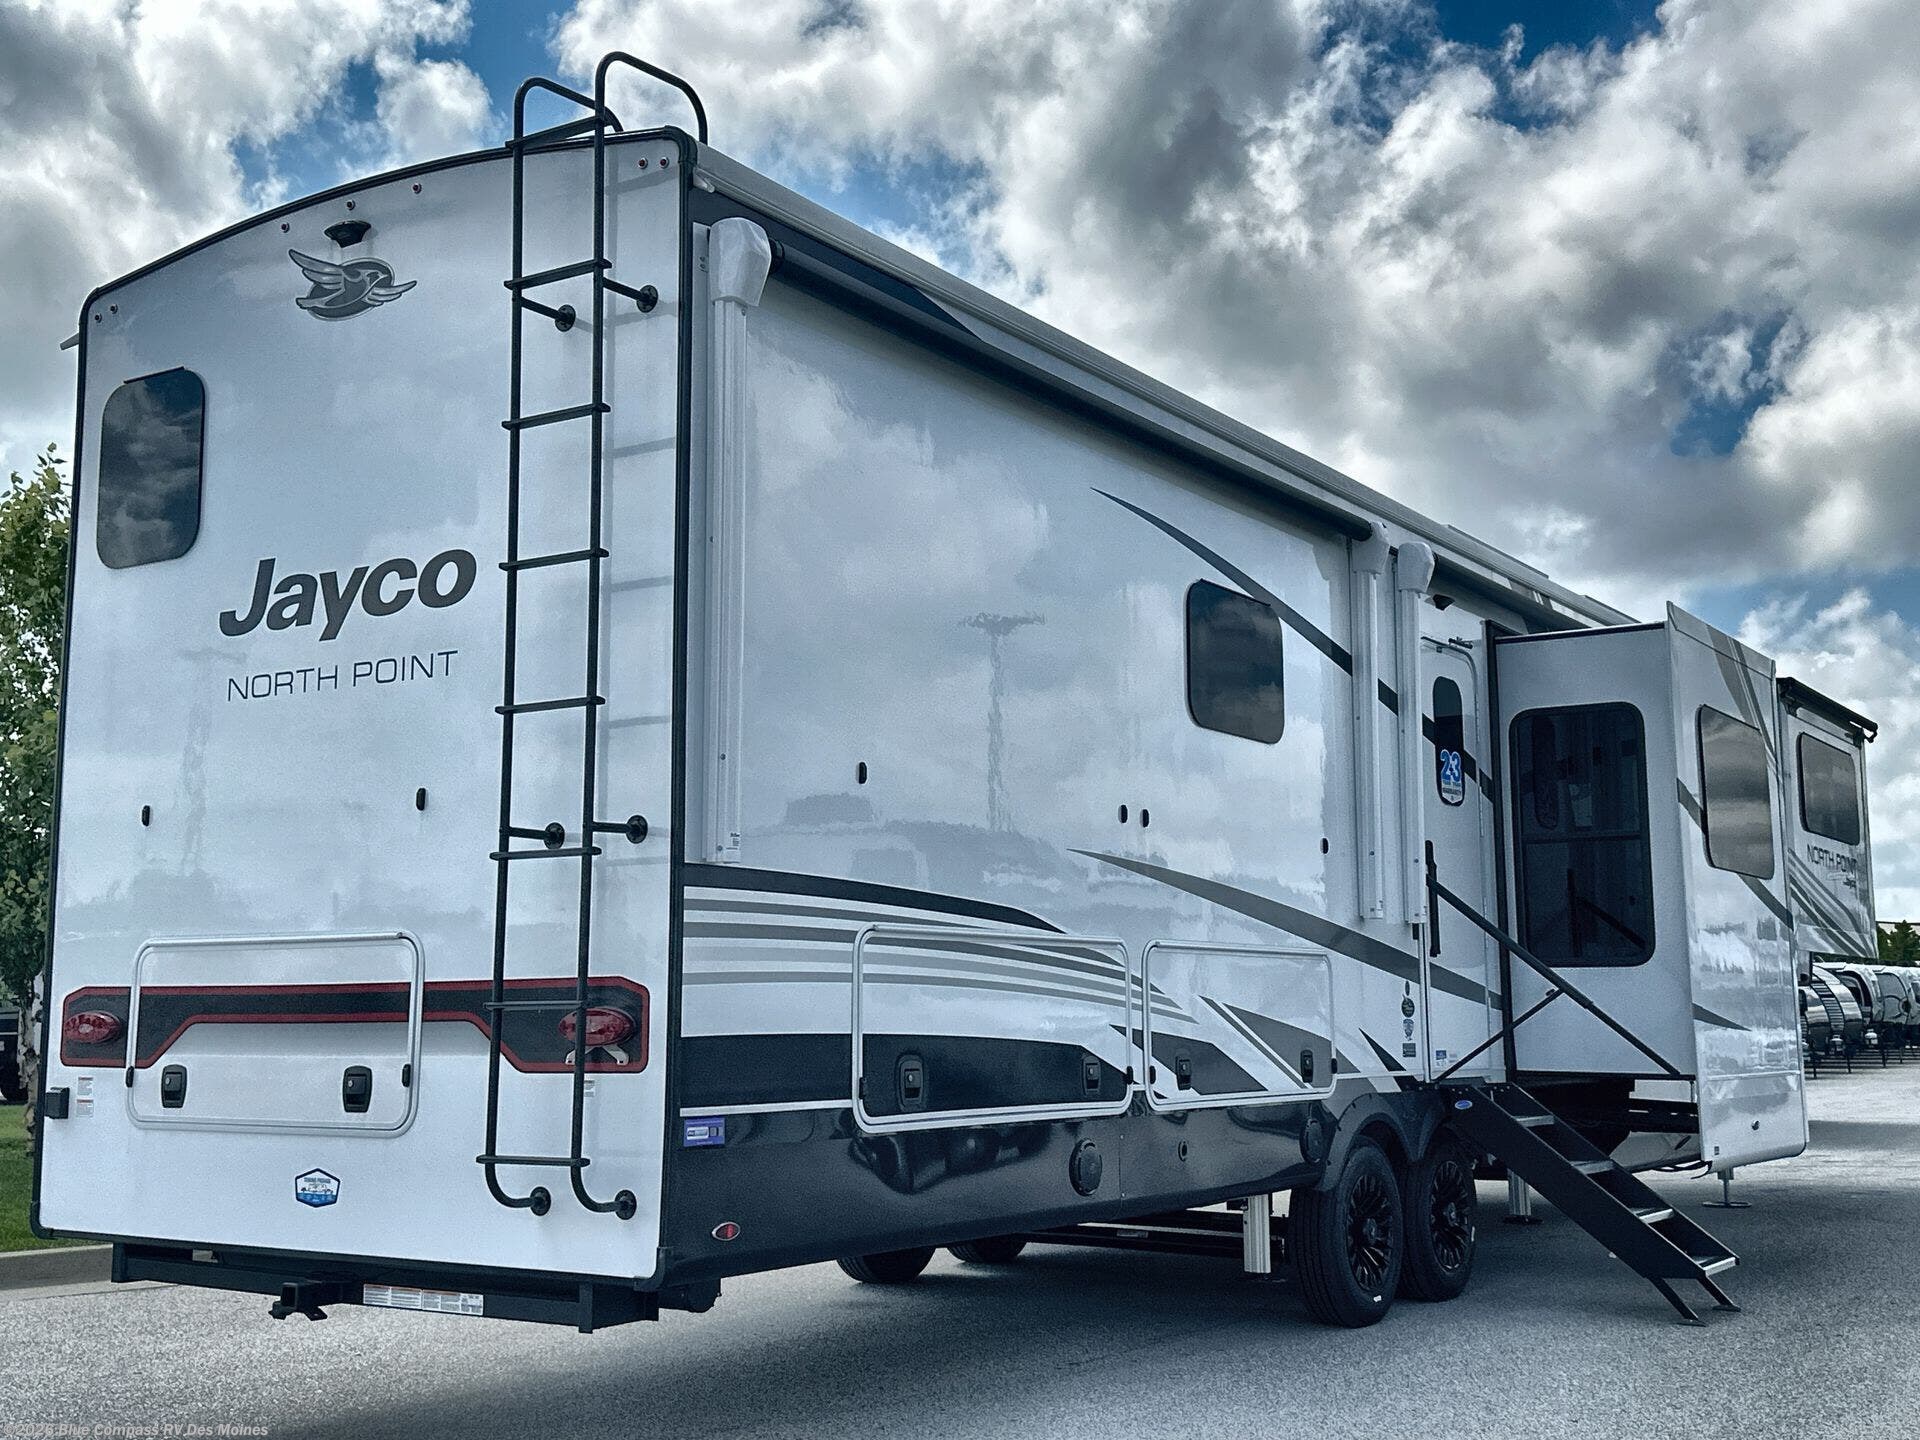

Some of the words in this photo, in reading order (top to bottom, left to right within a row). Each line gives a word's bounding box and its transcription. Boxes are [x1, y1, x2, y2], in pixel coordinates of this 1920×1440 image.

[219, 549, 477, 641] Jayco
[227, 665, 338, 701] NORTH
[353, 650, 458, 686] POINT
[1807, 844, 1834, 869] NORTH
